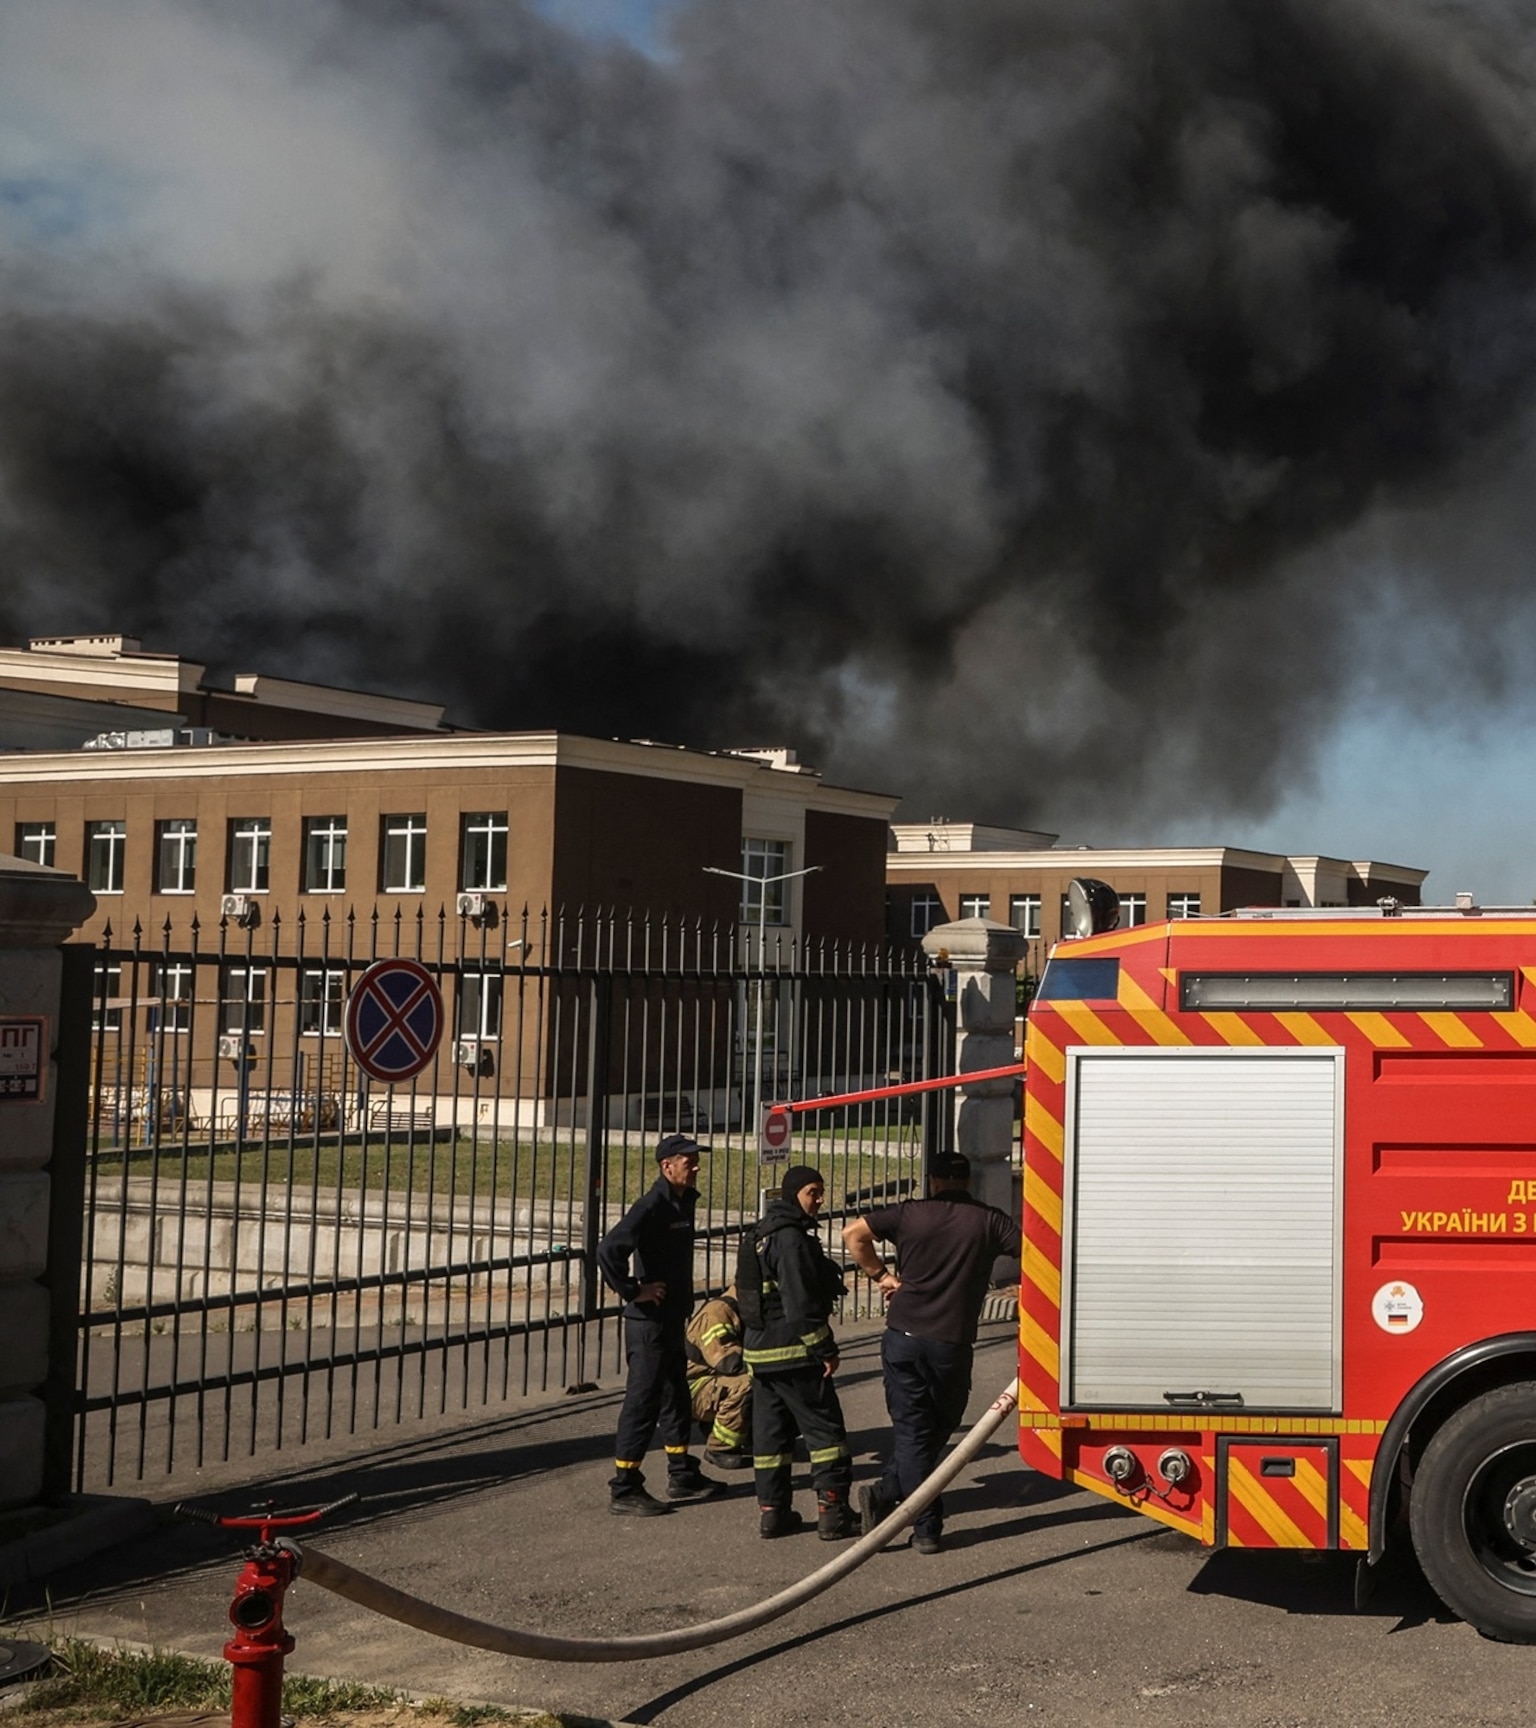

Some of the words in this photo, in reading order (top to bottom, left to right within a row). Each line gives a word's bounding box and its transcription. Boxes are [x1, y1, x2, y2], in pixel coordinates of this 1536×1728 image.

[2, 1028, 34, 1047] ПГ
[1401, 1209, 1507, 1233] УКРАЇНИ
[1513, 1213, 1528, 1233] З
